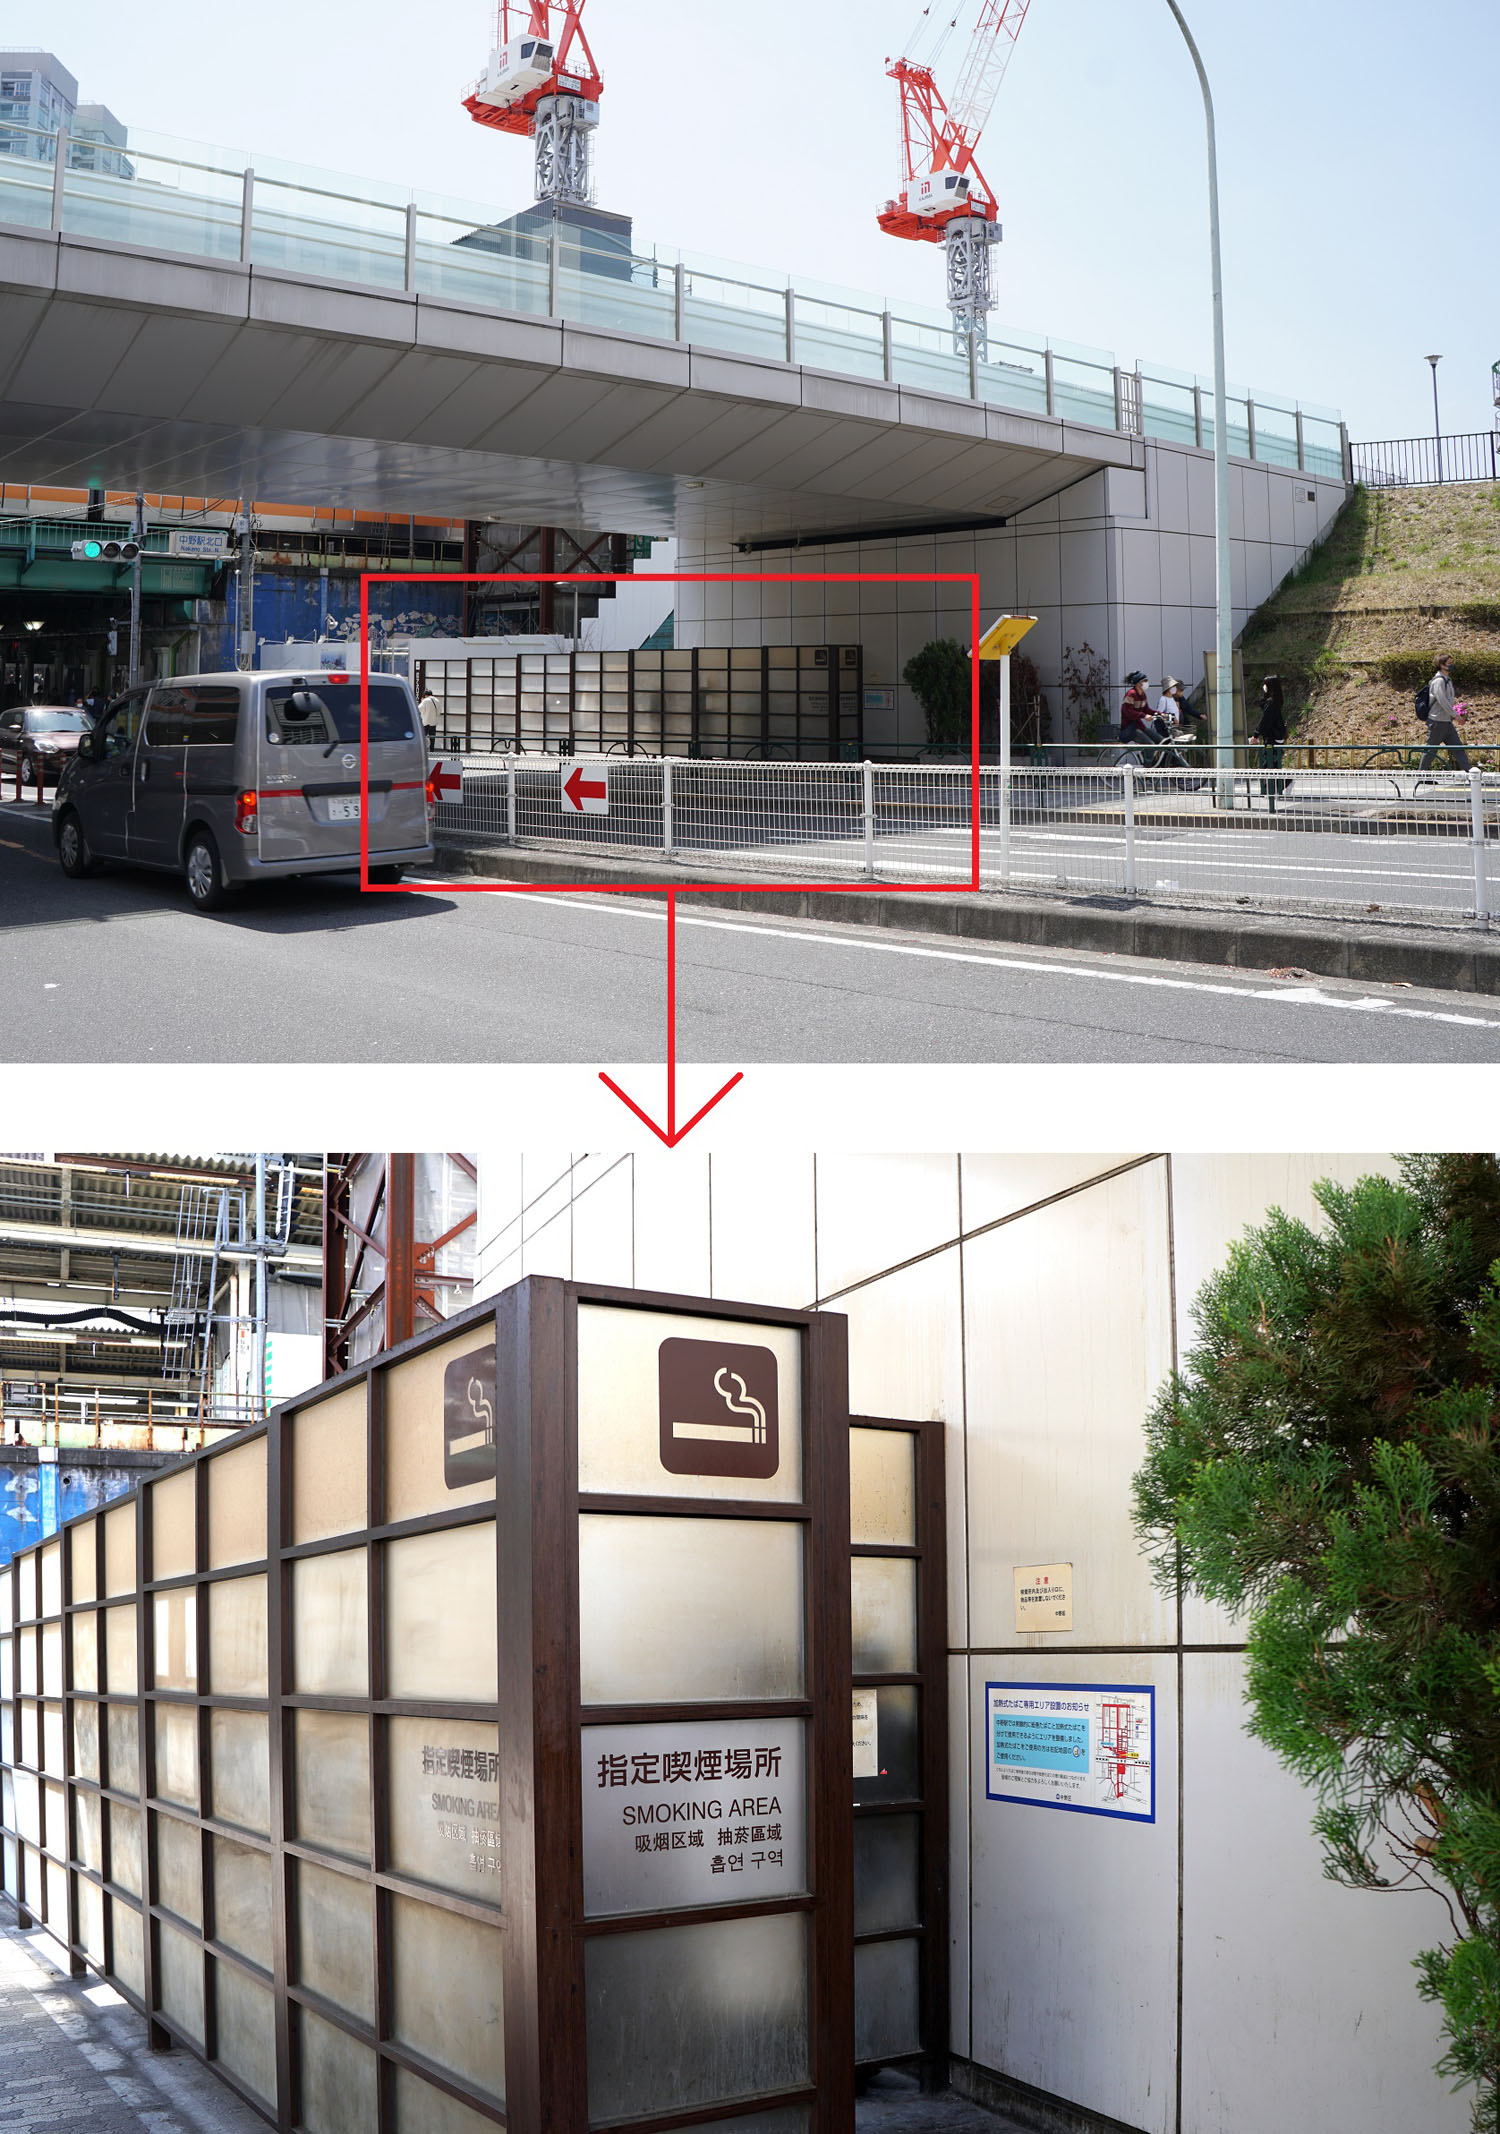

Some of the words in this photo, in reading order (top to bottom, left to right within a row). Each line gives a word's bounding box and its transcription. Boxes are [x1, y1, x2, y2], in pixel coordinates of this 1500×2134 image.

[179, 535, 222, 546] 中野駅北口
[597, 1746, 782, 1788] 指定喫煙場所
[432, 1792, 475, 1818] SMOKING
[622, 1800, 722, 1826] SMOKING
[728, 1796, 782, 1818] AREA
[635, 1829, 705, 1853] 吸烟区域
[717, 1823, 782, 1846] 抽菸區域
[710, 1852, 744, 1874] 흡연
[750, 1849, 783, 1870] 구역
